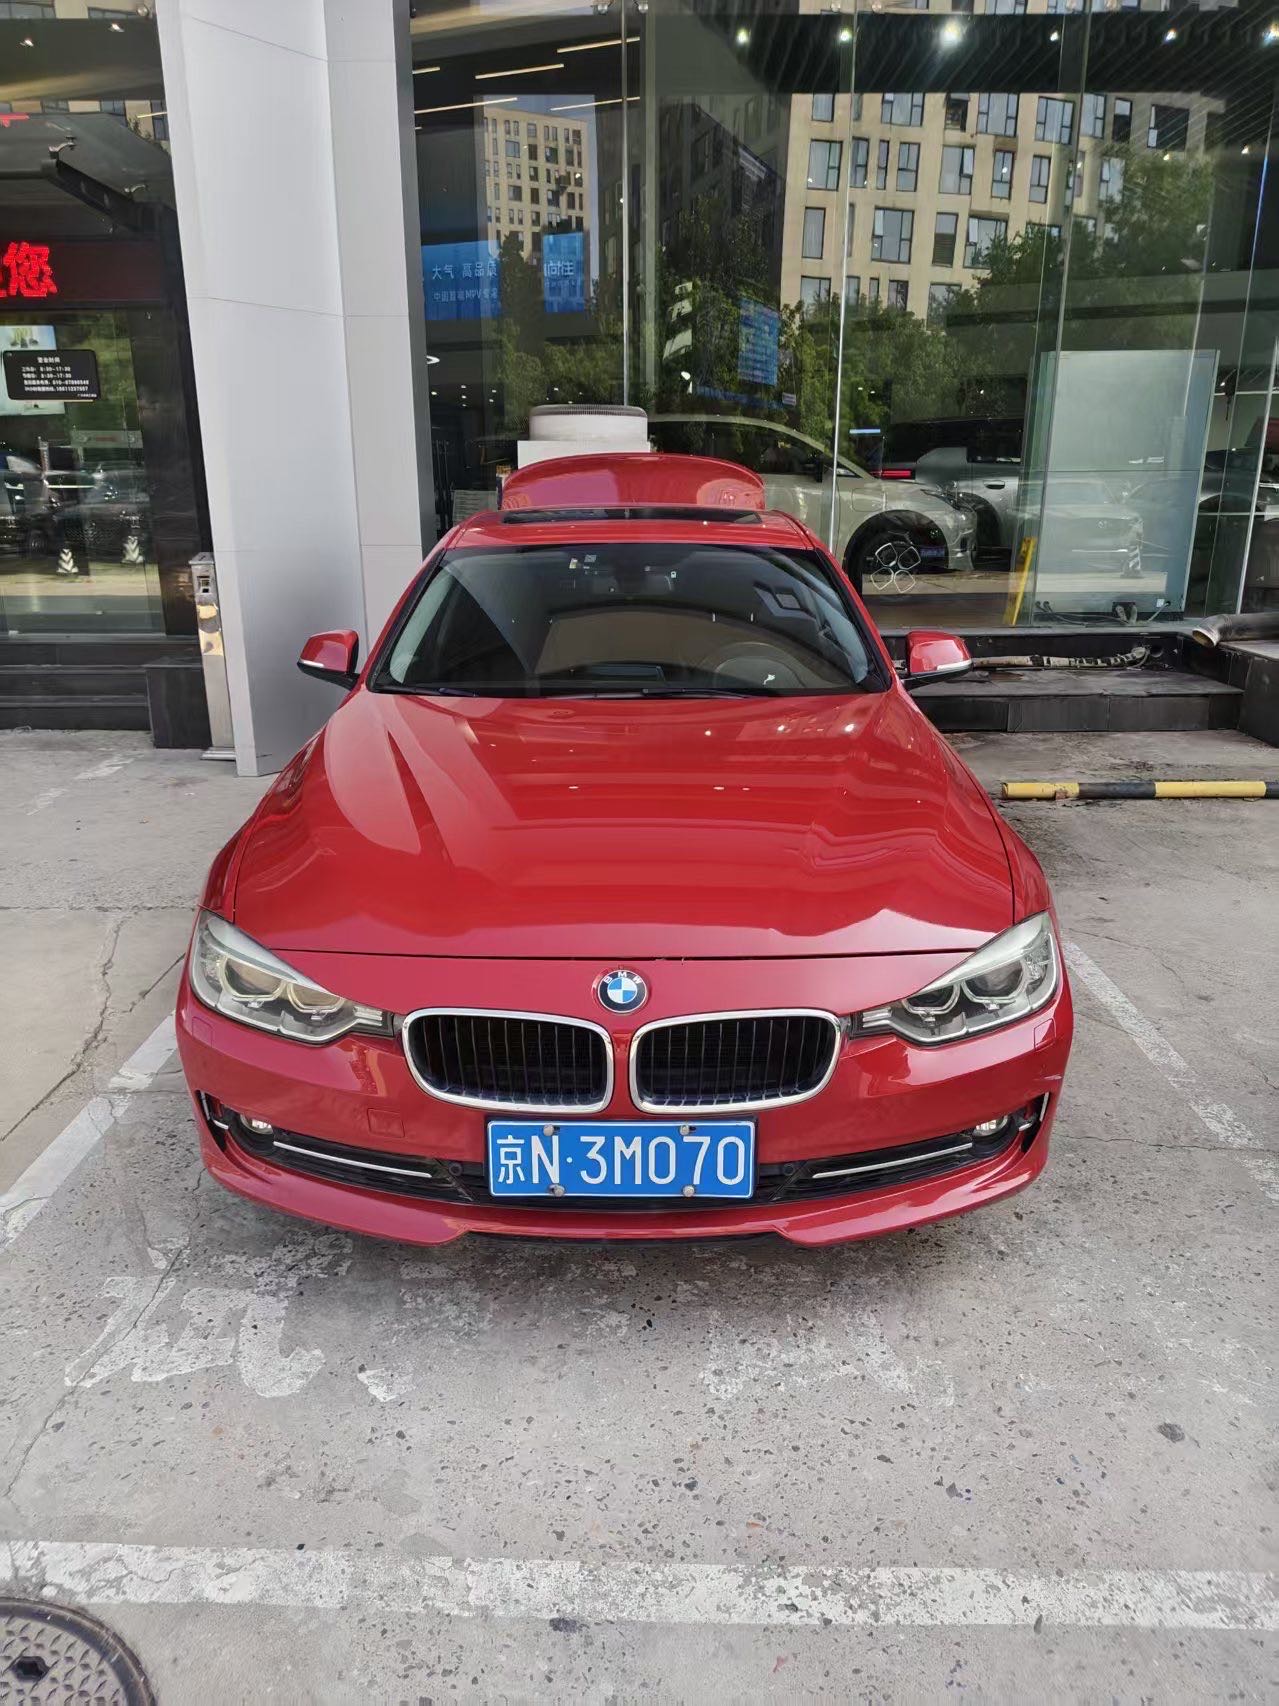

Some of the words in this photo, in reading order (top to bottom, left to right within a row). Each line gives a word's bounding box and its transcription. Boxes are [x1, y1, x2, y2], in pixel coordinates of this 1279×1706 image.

[0, 242, 57, 297] 您
[433, 264, 455, 280] 大气
[462, 261, 497, 278] 高品质
[603, 971, 643, 984] BMW
